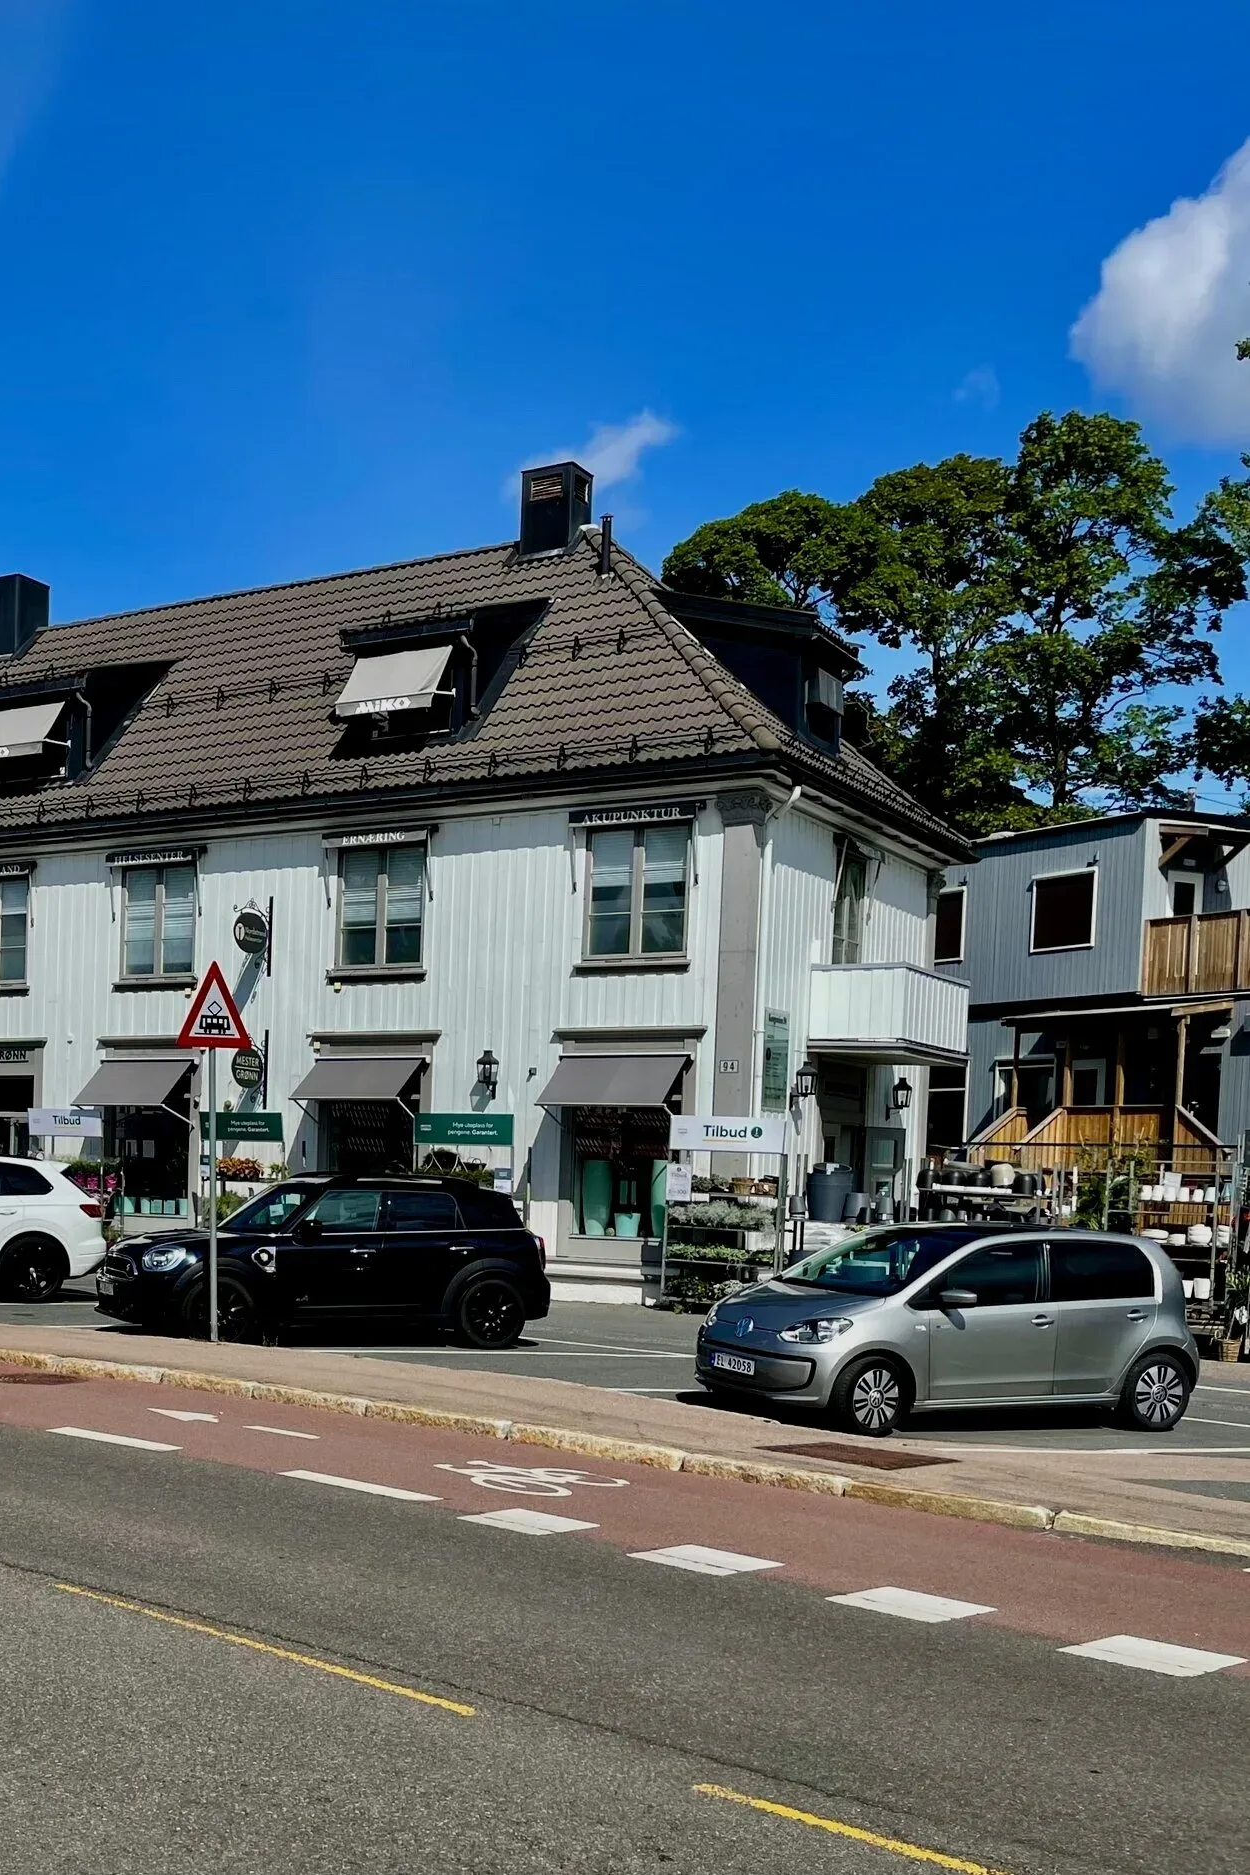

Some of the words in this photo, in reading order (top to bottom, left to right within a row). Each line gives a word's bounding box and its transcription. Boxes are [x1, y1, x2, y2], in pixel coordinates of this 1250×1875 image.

[582, 806, 680, 825] AKUPUNKTUR
[342, 830, 405, 846] ERNÆRING
[114, 851, 183, 864] HELSESENTER
[235, 1055, 260, 1067] MESTER
[723, 1061, 735, 1072] 94
[235, 1069, 259, 1081] GRØNN
[52, 1115, 81, 1126] Tilbud
[703, 1124, 748, 1138] Tilbud
[716, 1354, 725, 1367] EL
[727, 1357, 752, 1373] 42058
